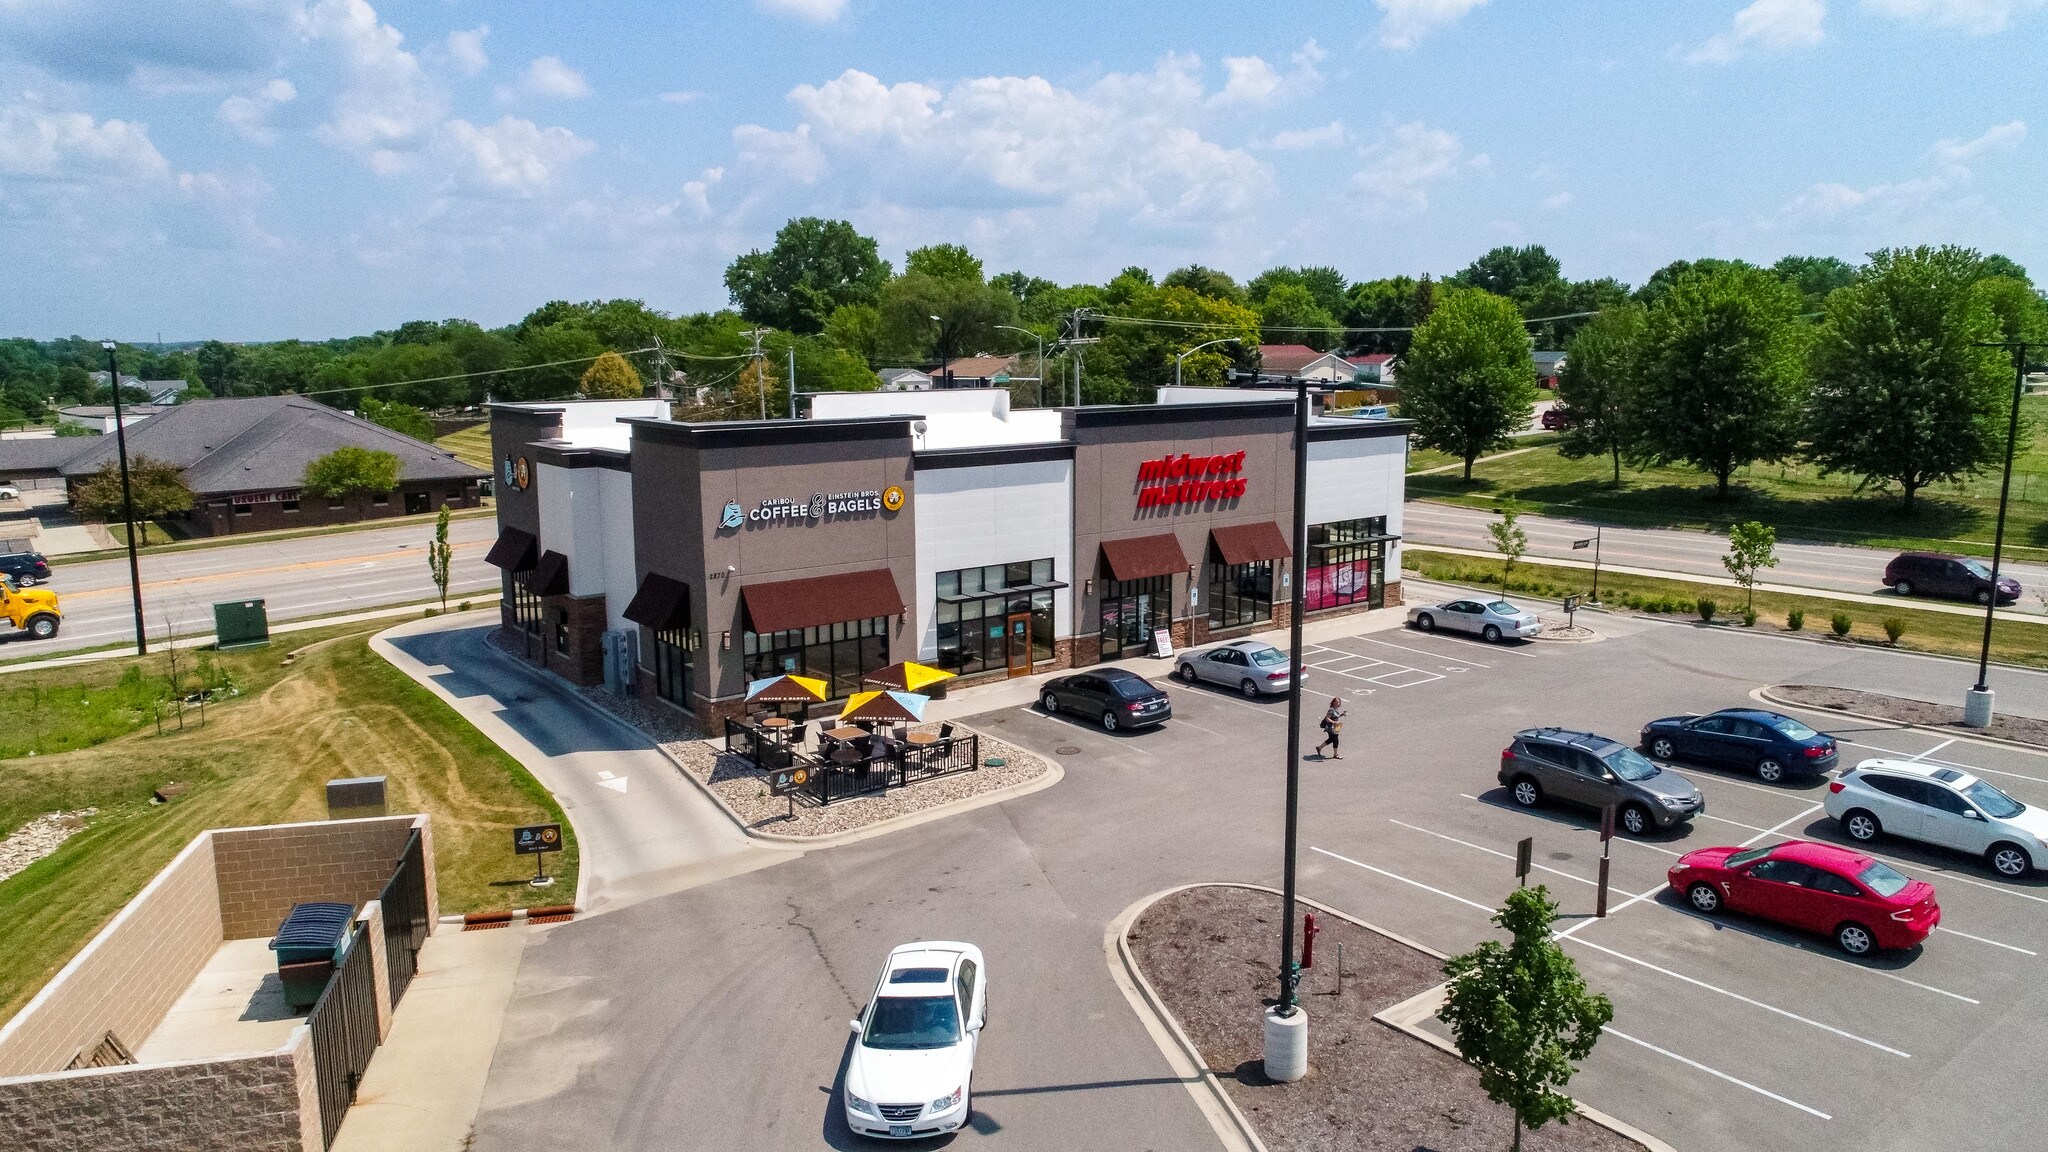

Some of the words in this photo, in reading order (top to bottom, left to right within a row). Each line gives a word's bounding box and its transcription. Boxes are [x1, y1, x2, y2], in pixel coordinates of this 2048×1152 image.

[1137, 450, 1246, 481] midwest
[234, 492, 270, 504] URGENT
[762, 498, 795, 507] CARIBOU
[828, 491, 860, 500] EINSTEIN
[1136, 478, 1247, 508] mattress
[749, 504, 808, 520] COFFEE
[809, 493, 827, 518] &
[828, 498, 881, 514] BAGELS
